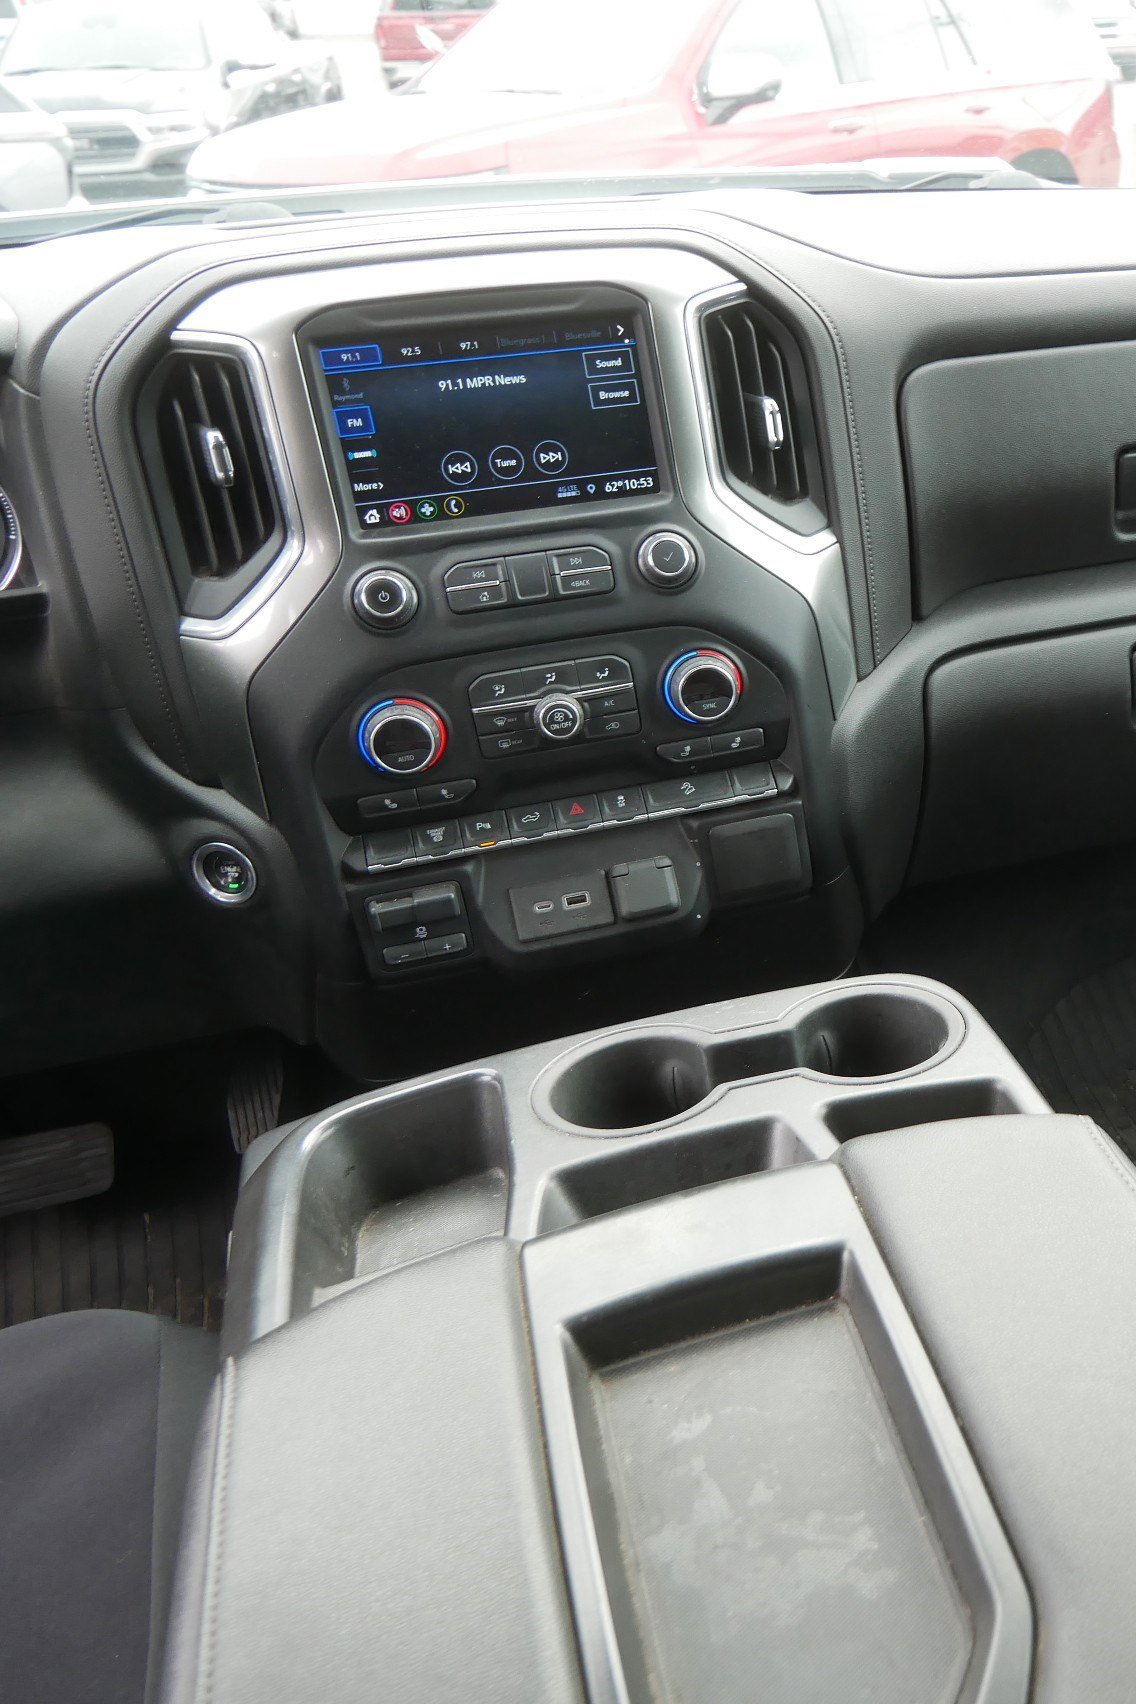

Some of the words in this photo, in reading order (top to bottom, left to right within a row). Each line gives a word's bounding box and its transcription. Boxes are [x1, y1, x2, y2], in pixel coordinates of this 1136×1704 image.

[564, 330, 602, 341] Bluesville
[401, 346, 422, 356] 92.5
[459, 341, 479, 351] 97.1
[341, 352, 361, 362] 91.1
[595, 357, 622, 369] Sound
[438, 378, 464, 392] 91.1
[466, 375, 495, 390] MPR
[495, 373, 527, 387] News
[599, 389, 630, 400] Browse
[347, 418, 363, 428] FM
[495, 458, 517, 468] Tune
[353, 482, 379, 492] More
[624, 477, 654, 490] 10:53
[575, 579, 591, 587] BACK
[604, 699, 615, 707] A/C
[702, 702, 717, 710] SYNC
[550, 720, 573, 730] ON/OFF
[398, 754, 415, 763] AUTO
